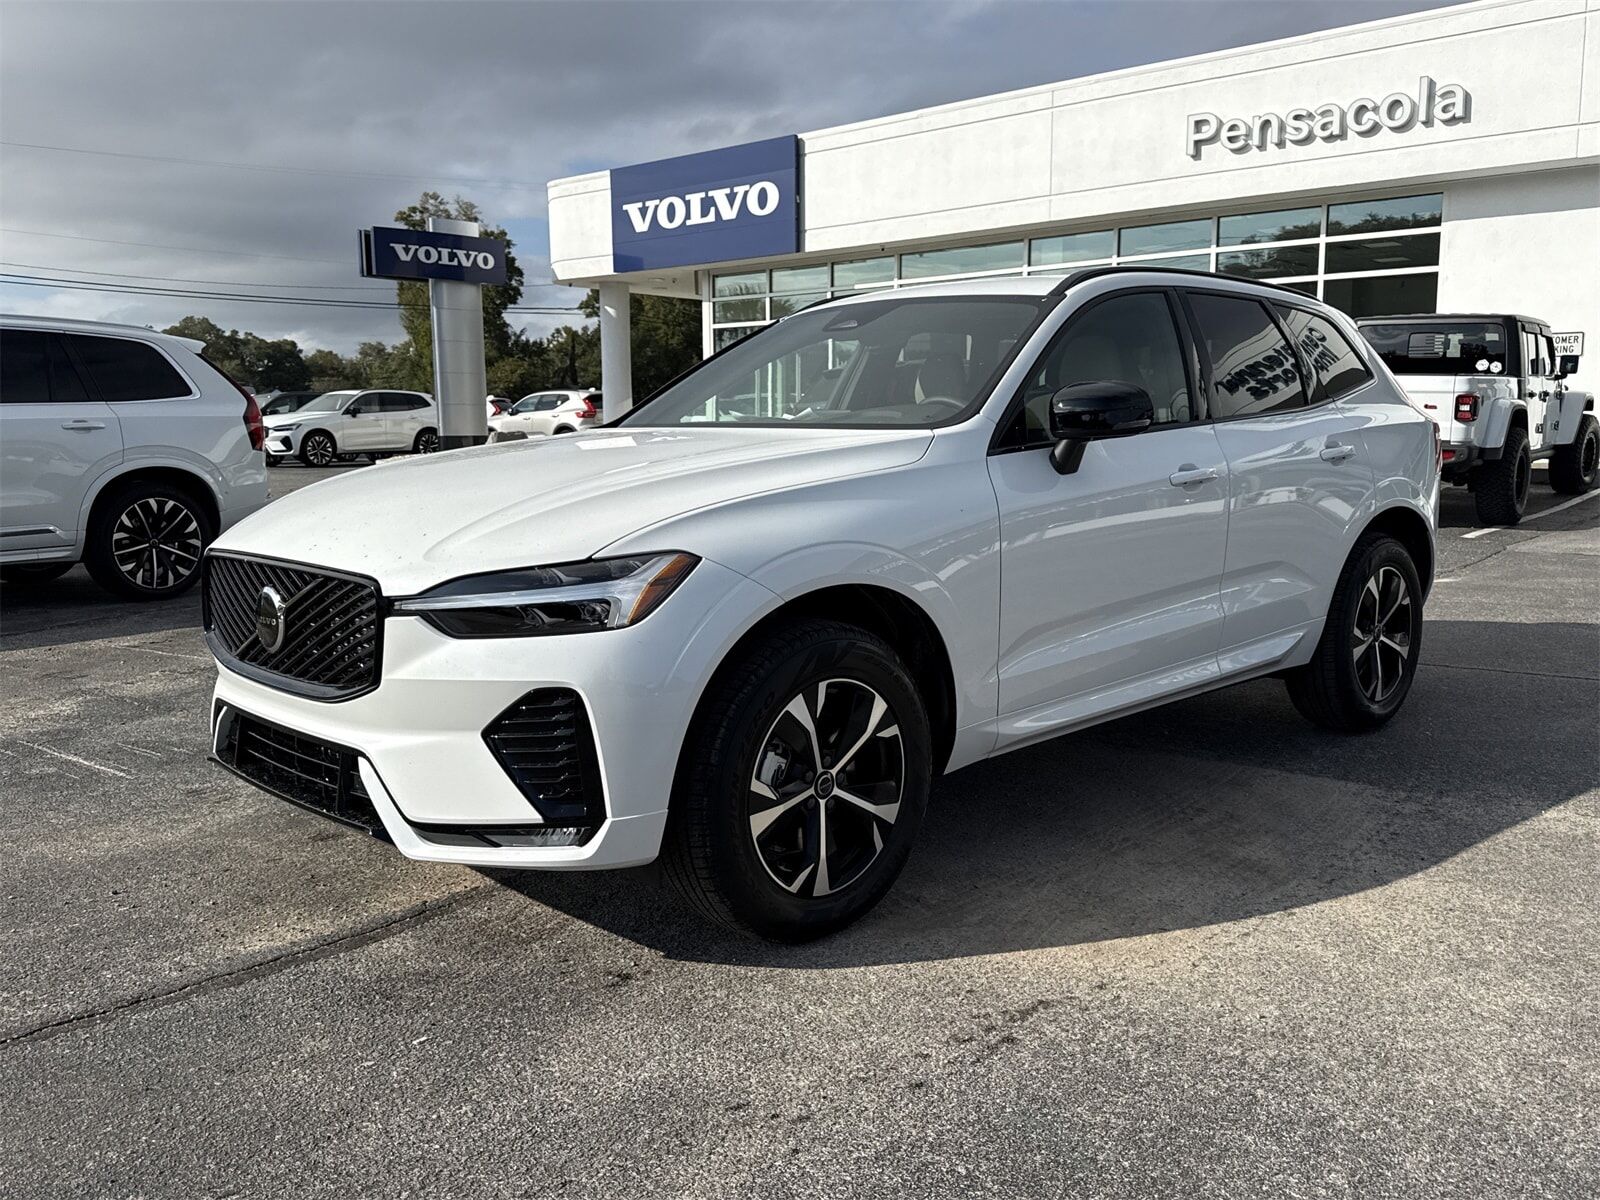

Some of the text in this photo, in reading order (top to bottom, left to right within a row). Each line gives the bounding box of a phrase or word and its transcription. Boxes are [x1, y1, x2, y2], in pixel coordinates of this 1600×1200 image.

[1186, 76, 1472, 160] Pensacola
[622, 181, 780, 233] VOLVO
[389, 243, 495, 270] VOLVO
[1552, 335, 1579, 344] OMER
